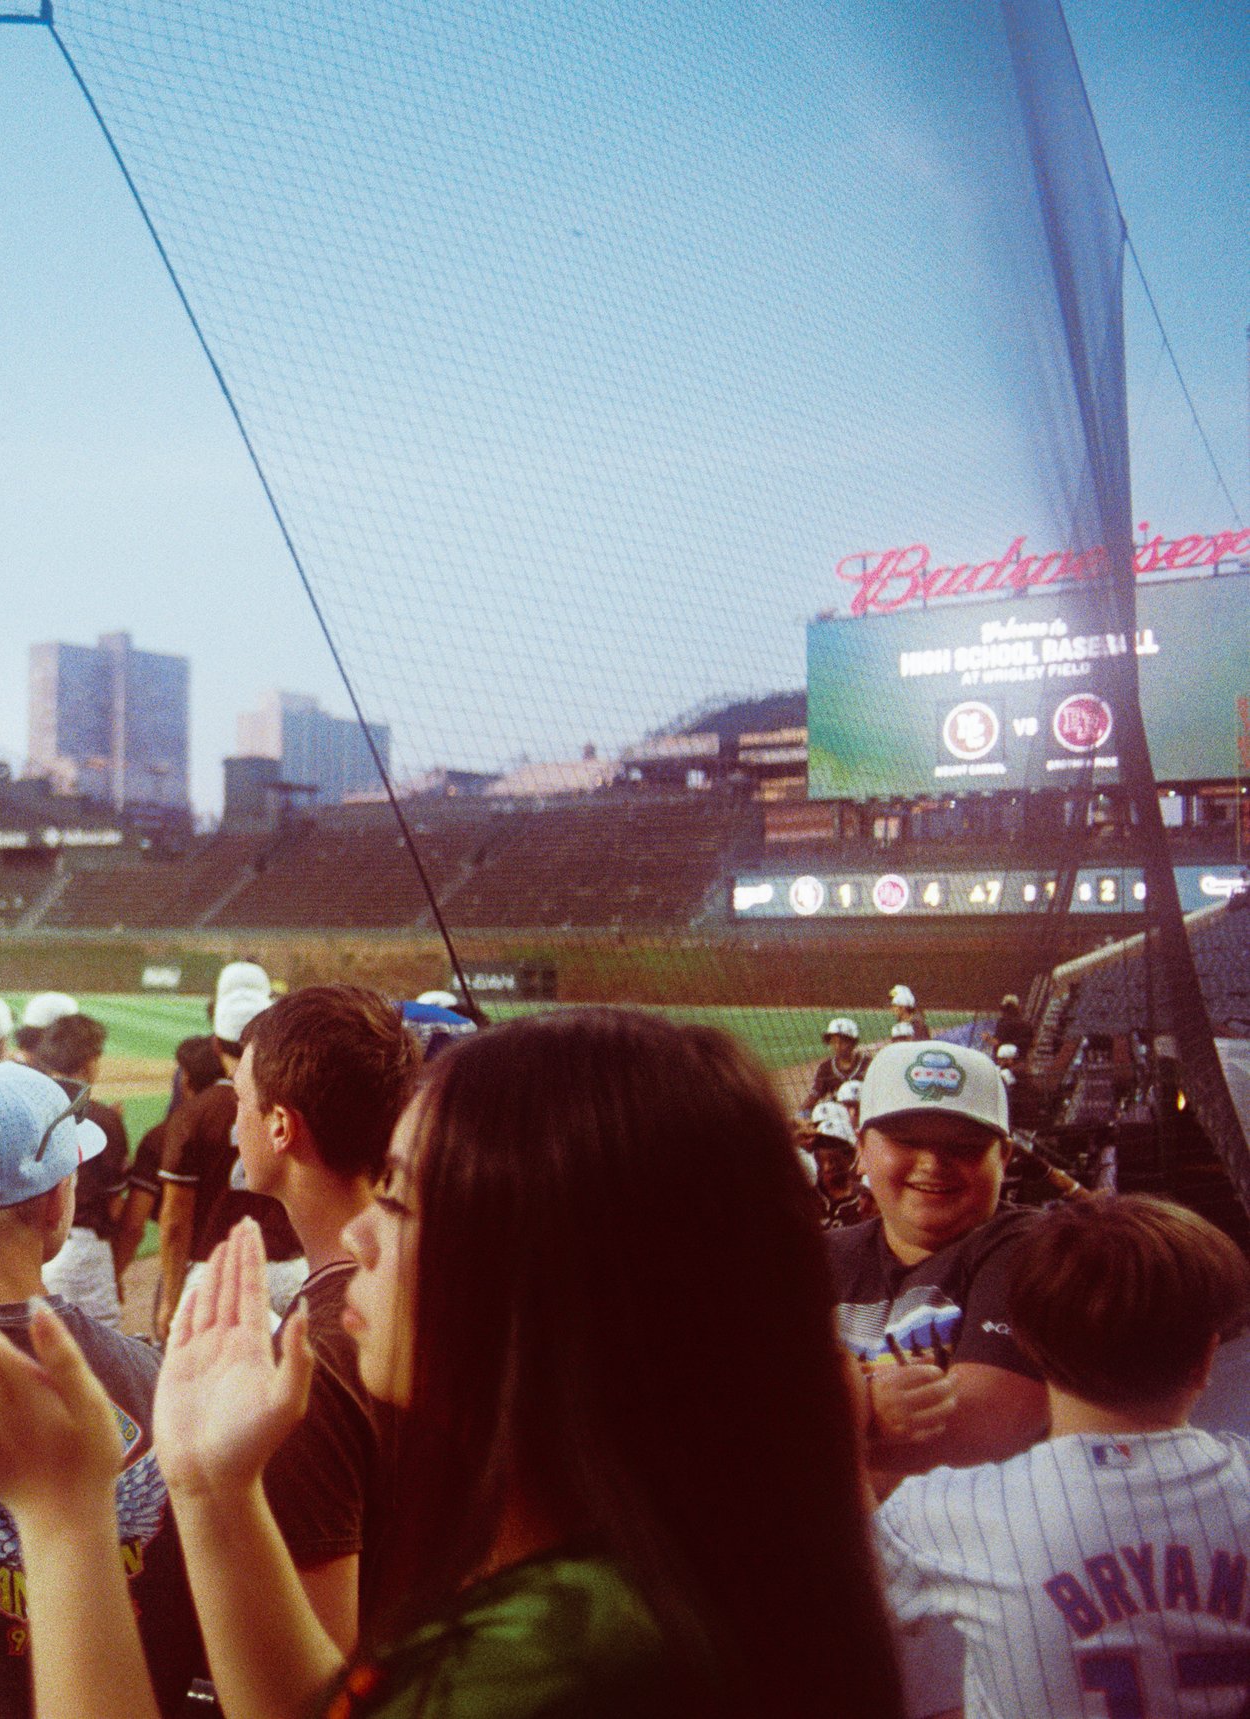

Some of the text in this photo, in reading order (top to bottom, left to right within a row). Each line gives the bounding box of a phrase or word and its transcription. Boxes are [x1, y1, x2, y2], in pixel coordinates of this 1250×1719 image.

[900, 649, 950, 677] HIGH
[954, 641, 1038, 671] SCHOOL
[961, 662, 1090, 685] AT WRIGLEY FIELD
[839, 883, 850, 908] 1
[923, 881, 940, 907] 4
[1101, 879, 1115, 901] 2
[1043, 1543, 1248, 1639] BRYAN
